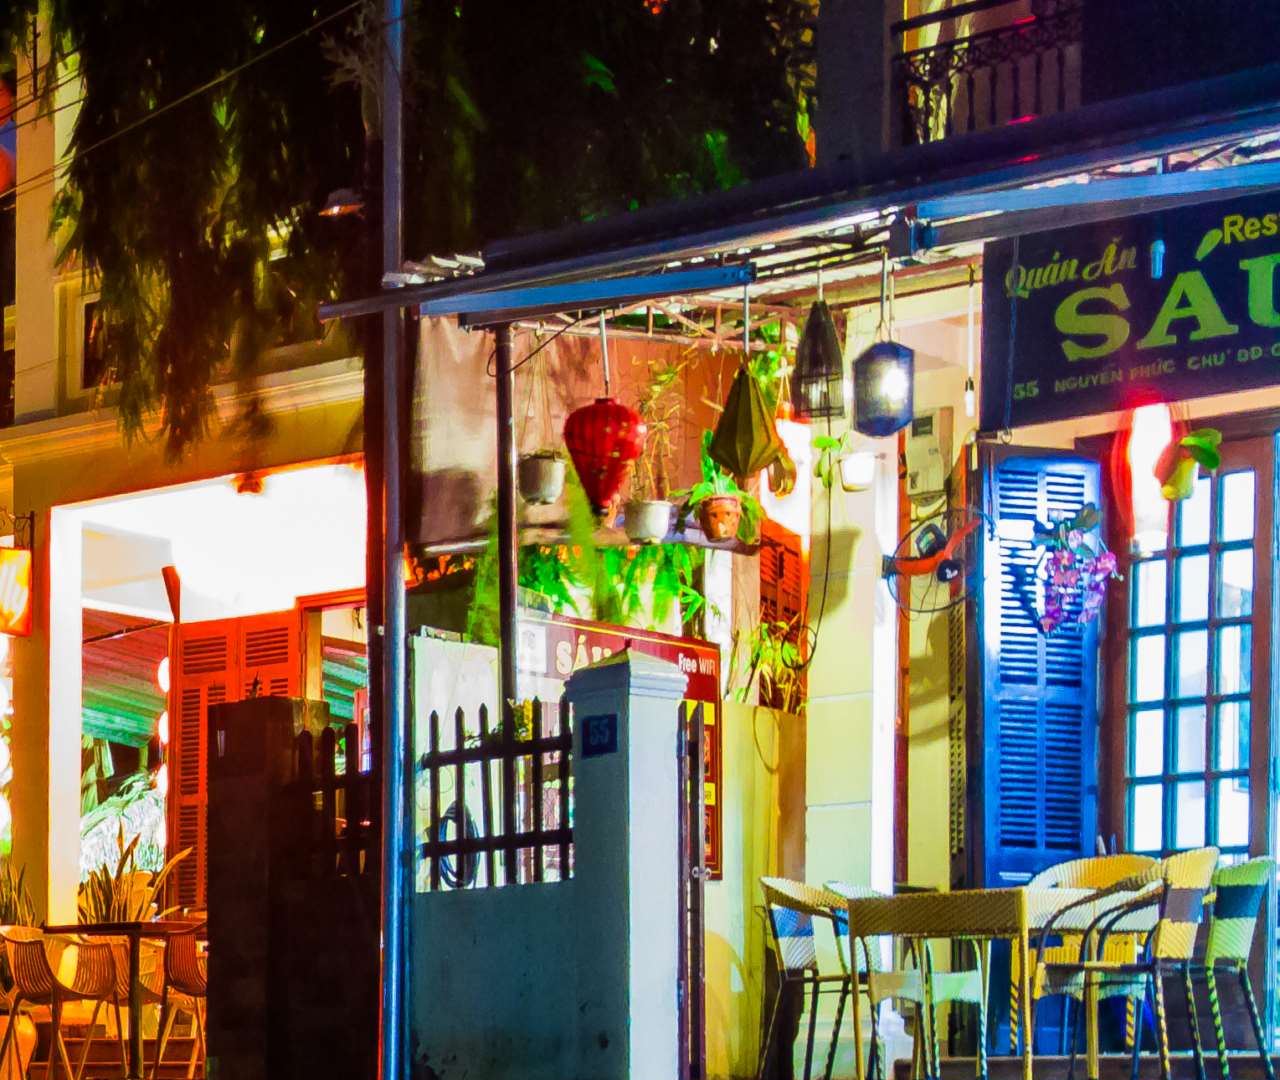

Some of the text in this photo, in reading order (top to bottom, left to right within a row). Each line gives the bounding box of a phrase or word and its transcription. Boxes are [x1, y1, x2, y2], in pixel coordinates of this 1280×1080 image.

[1223, 213, 1280, 245] Res
[1013, 379, 1039, 400] 55
[678, 652, 697, 674] Free
